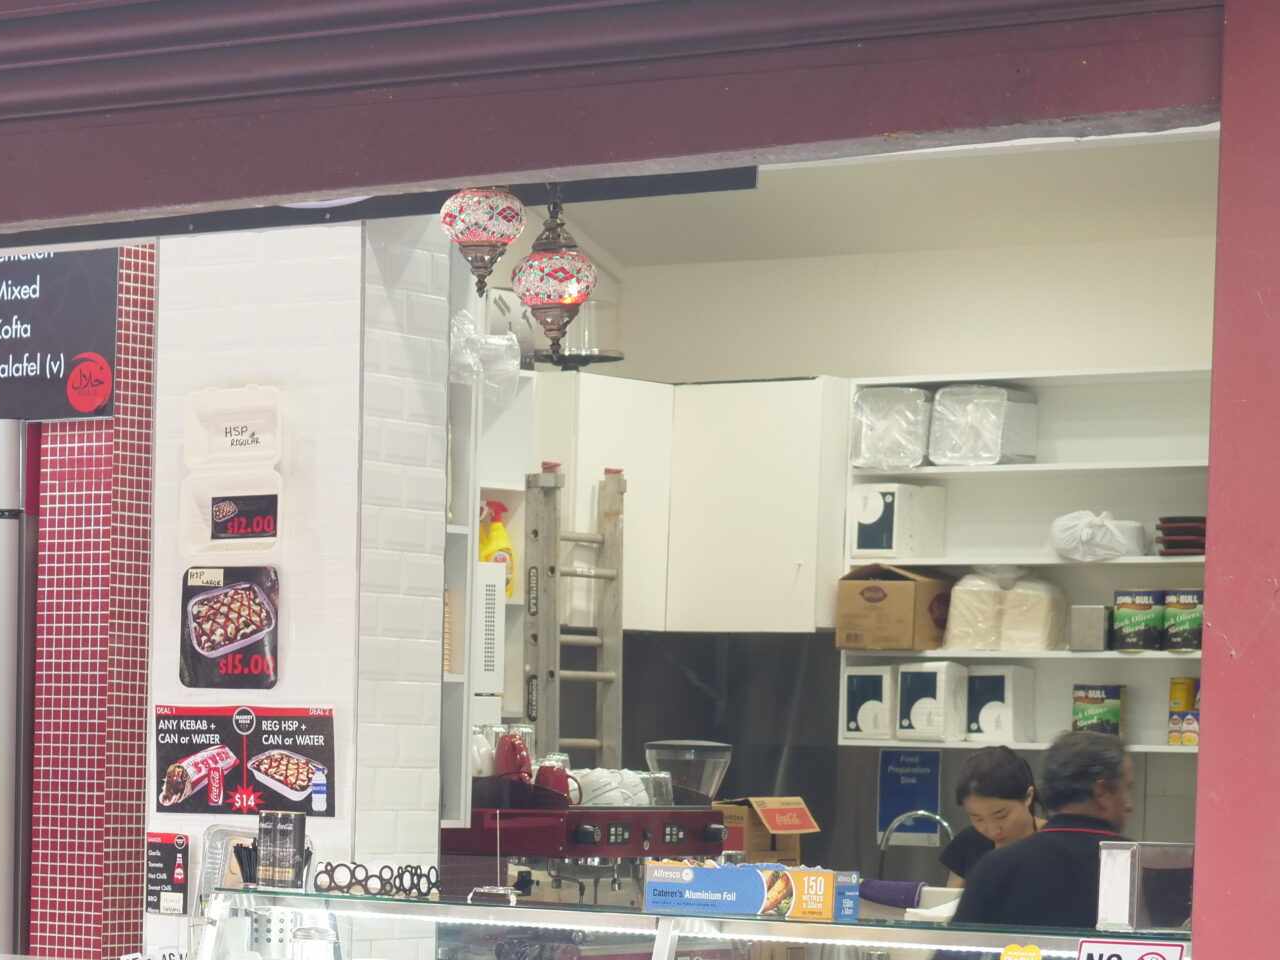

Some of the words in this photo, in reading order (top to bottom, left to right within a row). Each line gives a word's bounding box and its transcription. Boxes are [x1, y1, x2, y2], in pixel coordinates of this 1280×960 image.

[45, 353, 65, 378] (v)
[224, 425, 248, 438] HSP
[227, 515, 275, 535] $12.00
[158, 720, 177, 730] ANY
[180, 719, 208, 730] KEBAB
[262, 720, 280, 731] REG
[282, 720, 299, 731] HSP
[158, 733, 179, 744] CAN
[180, 736, 190, 744] or
[192, 734, 221, 745] WATER
[262, 735, 282, 745] CAN
[284, 737, 294, 745] or
[296, 735, 325, 746] WATER
[234, 794, 256, 808] $14
[652, 869, 681, 879] Alfresco
[803, 876, 825, 895] 150
[685, 890, 722, 900] Aluminium
[722, 891, 736, 901] Foil
